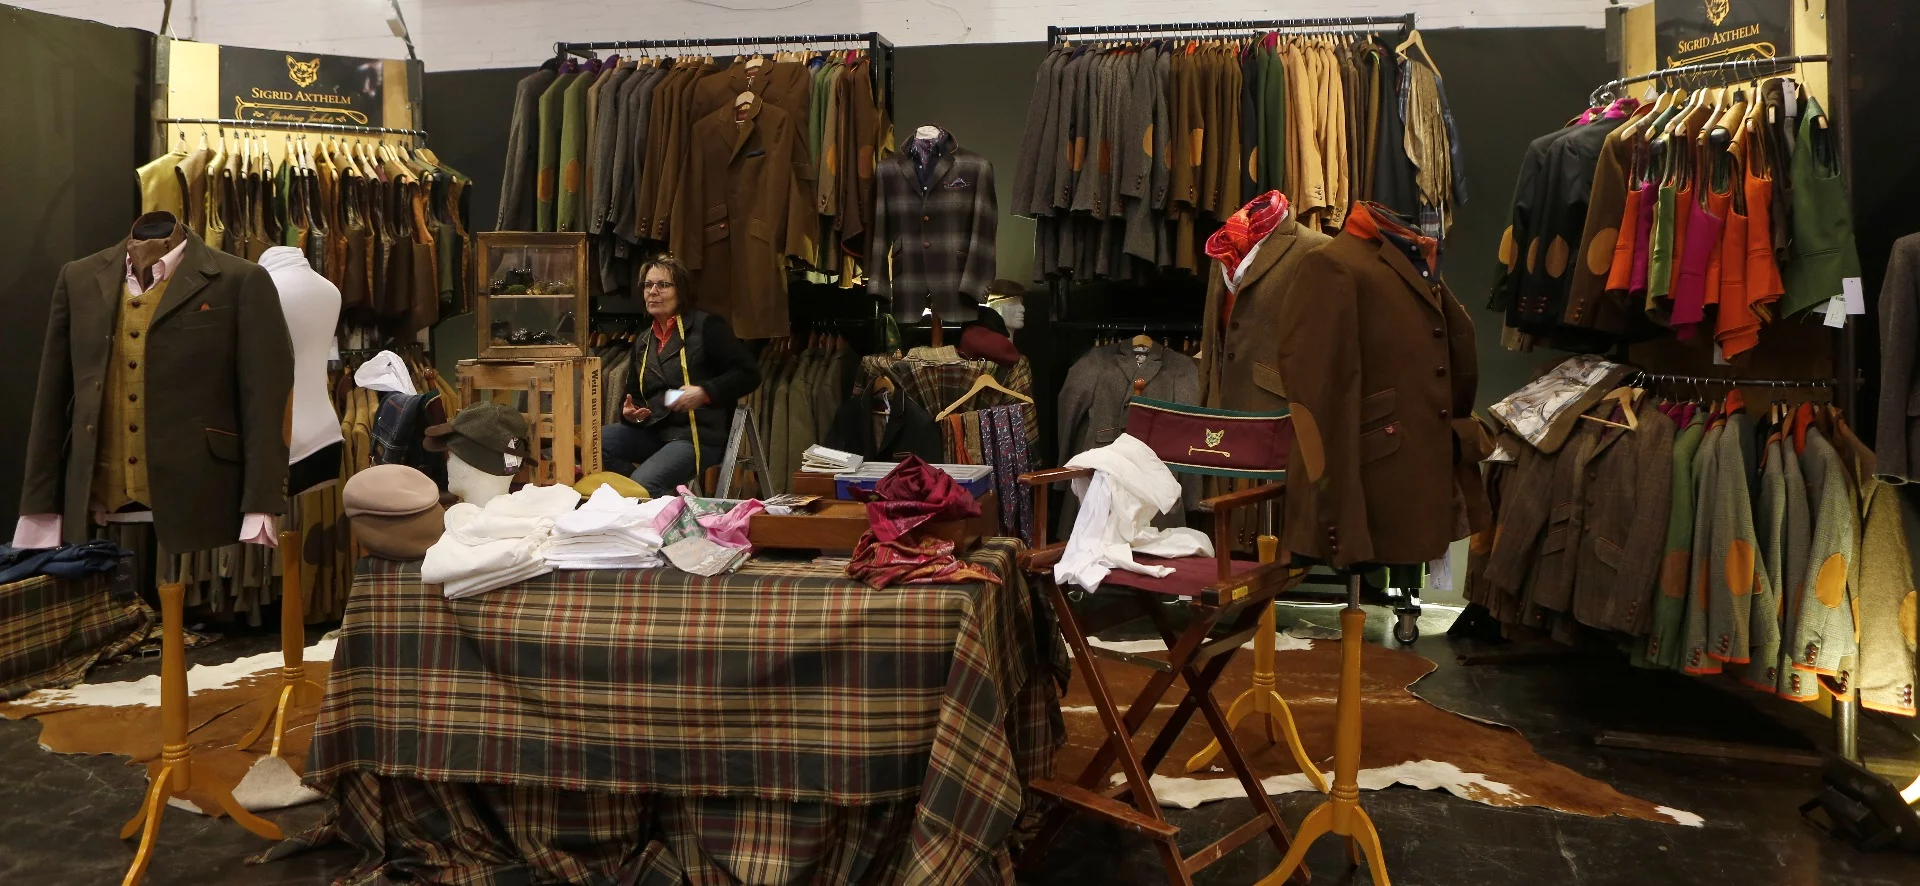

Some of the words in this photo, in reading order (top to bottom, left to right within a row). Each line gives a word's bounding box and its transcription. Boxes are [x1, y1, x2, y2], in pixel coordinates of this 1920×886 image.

[1678, 36, 1710, 54] SIGRID
[1711, 23, 1760, 46] AXTHELM
[251, 87, 293, 100] SIGRID
[295, 91, 352, 104] AXTHELM
[591, 368, 599, 396] Wein
